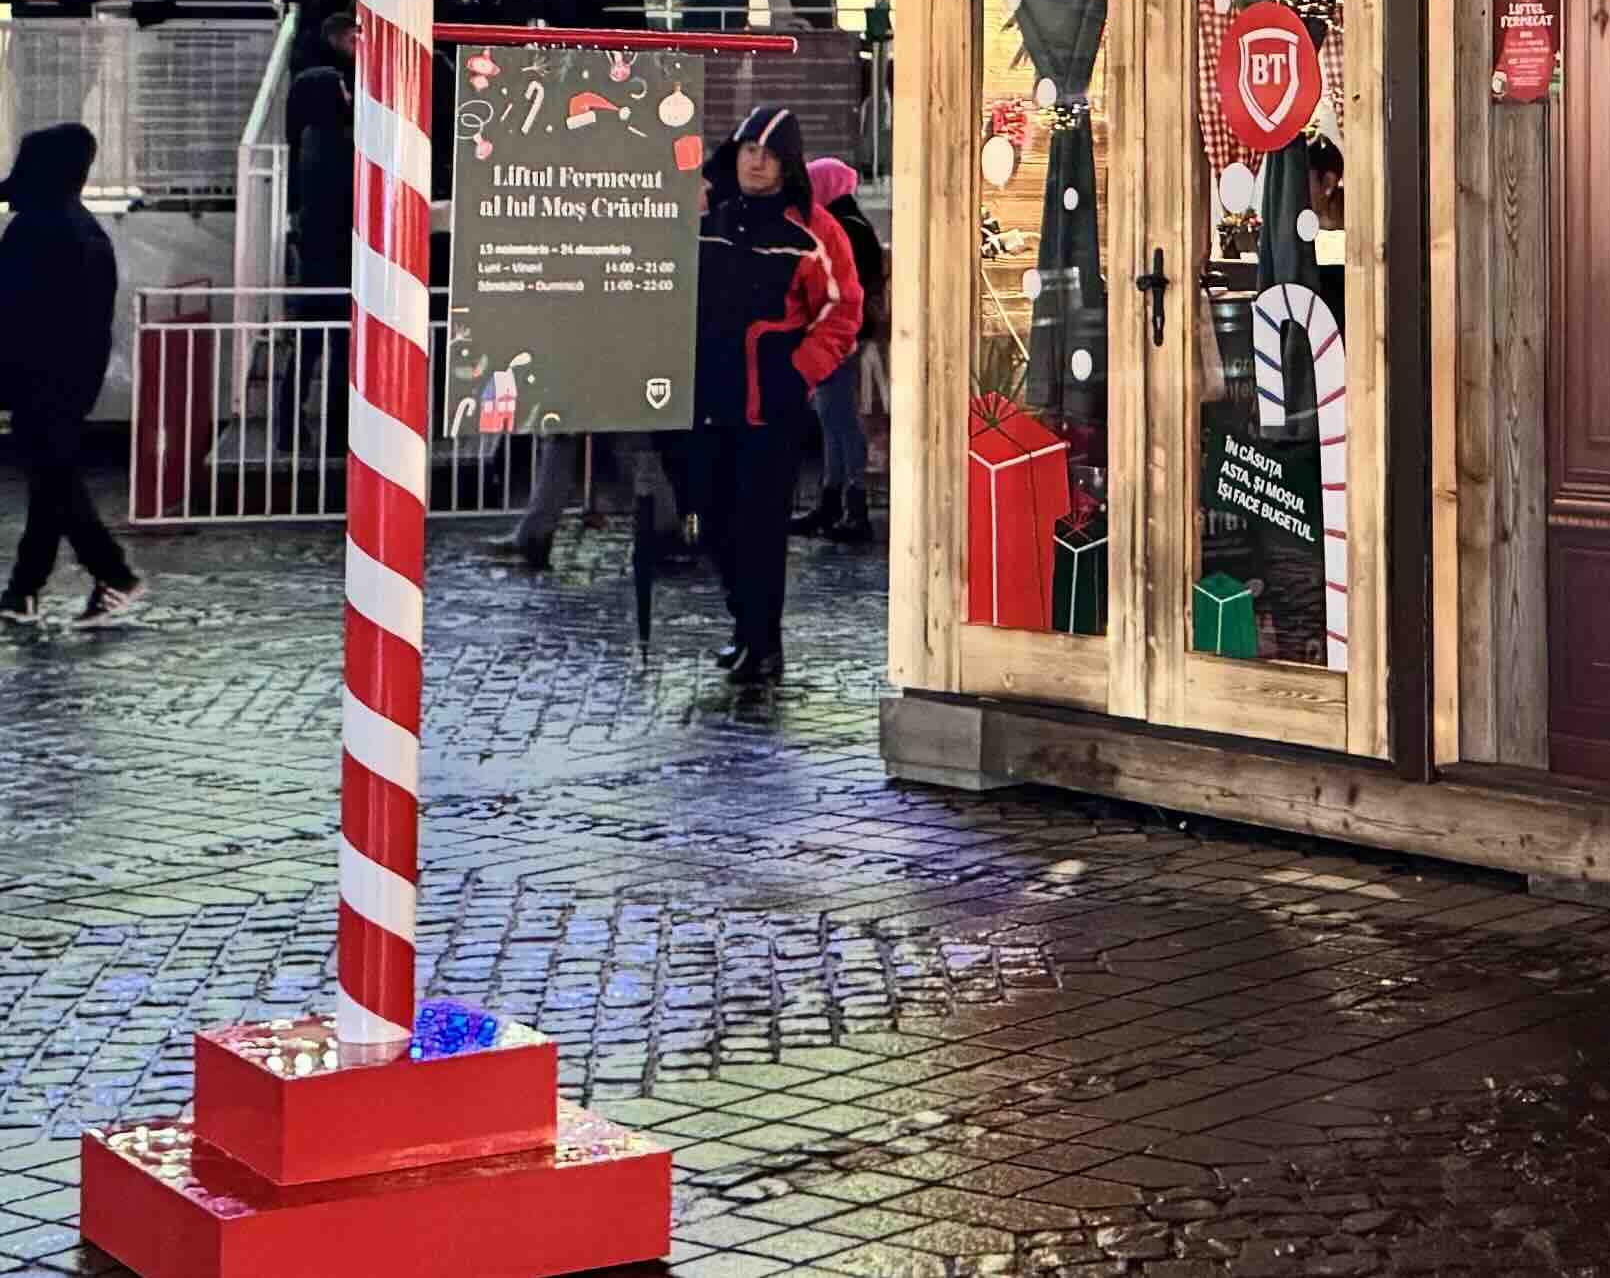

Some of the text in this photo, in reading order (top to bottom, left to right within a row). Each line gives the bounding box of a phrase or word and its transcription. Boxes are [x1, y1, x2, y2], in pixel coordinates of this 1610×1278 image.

[1251, 53, 1287, 84] BT
[493, 164, 662, 189] Liftul Fermecat
[479, 195, 679, 223] al lui Moș Crăciun
[1225, 434, 1283, 479] ÎN CĂSUȚA
[1217, 476, 1233, 502] ÎȘI
[1232, 488, 1260, 515] FACE
[1220, 460, 1306, 515] ASTA, ȘI MOȘUL
